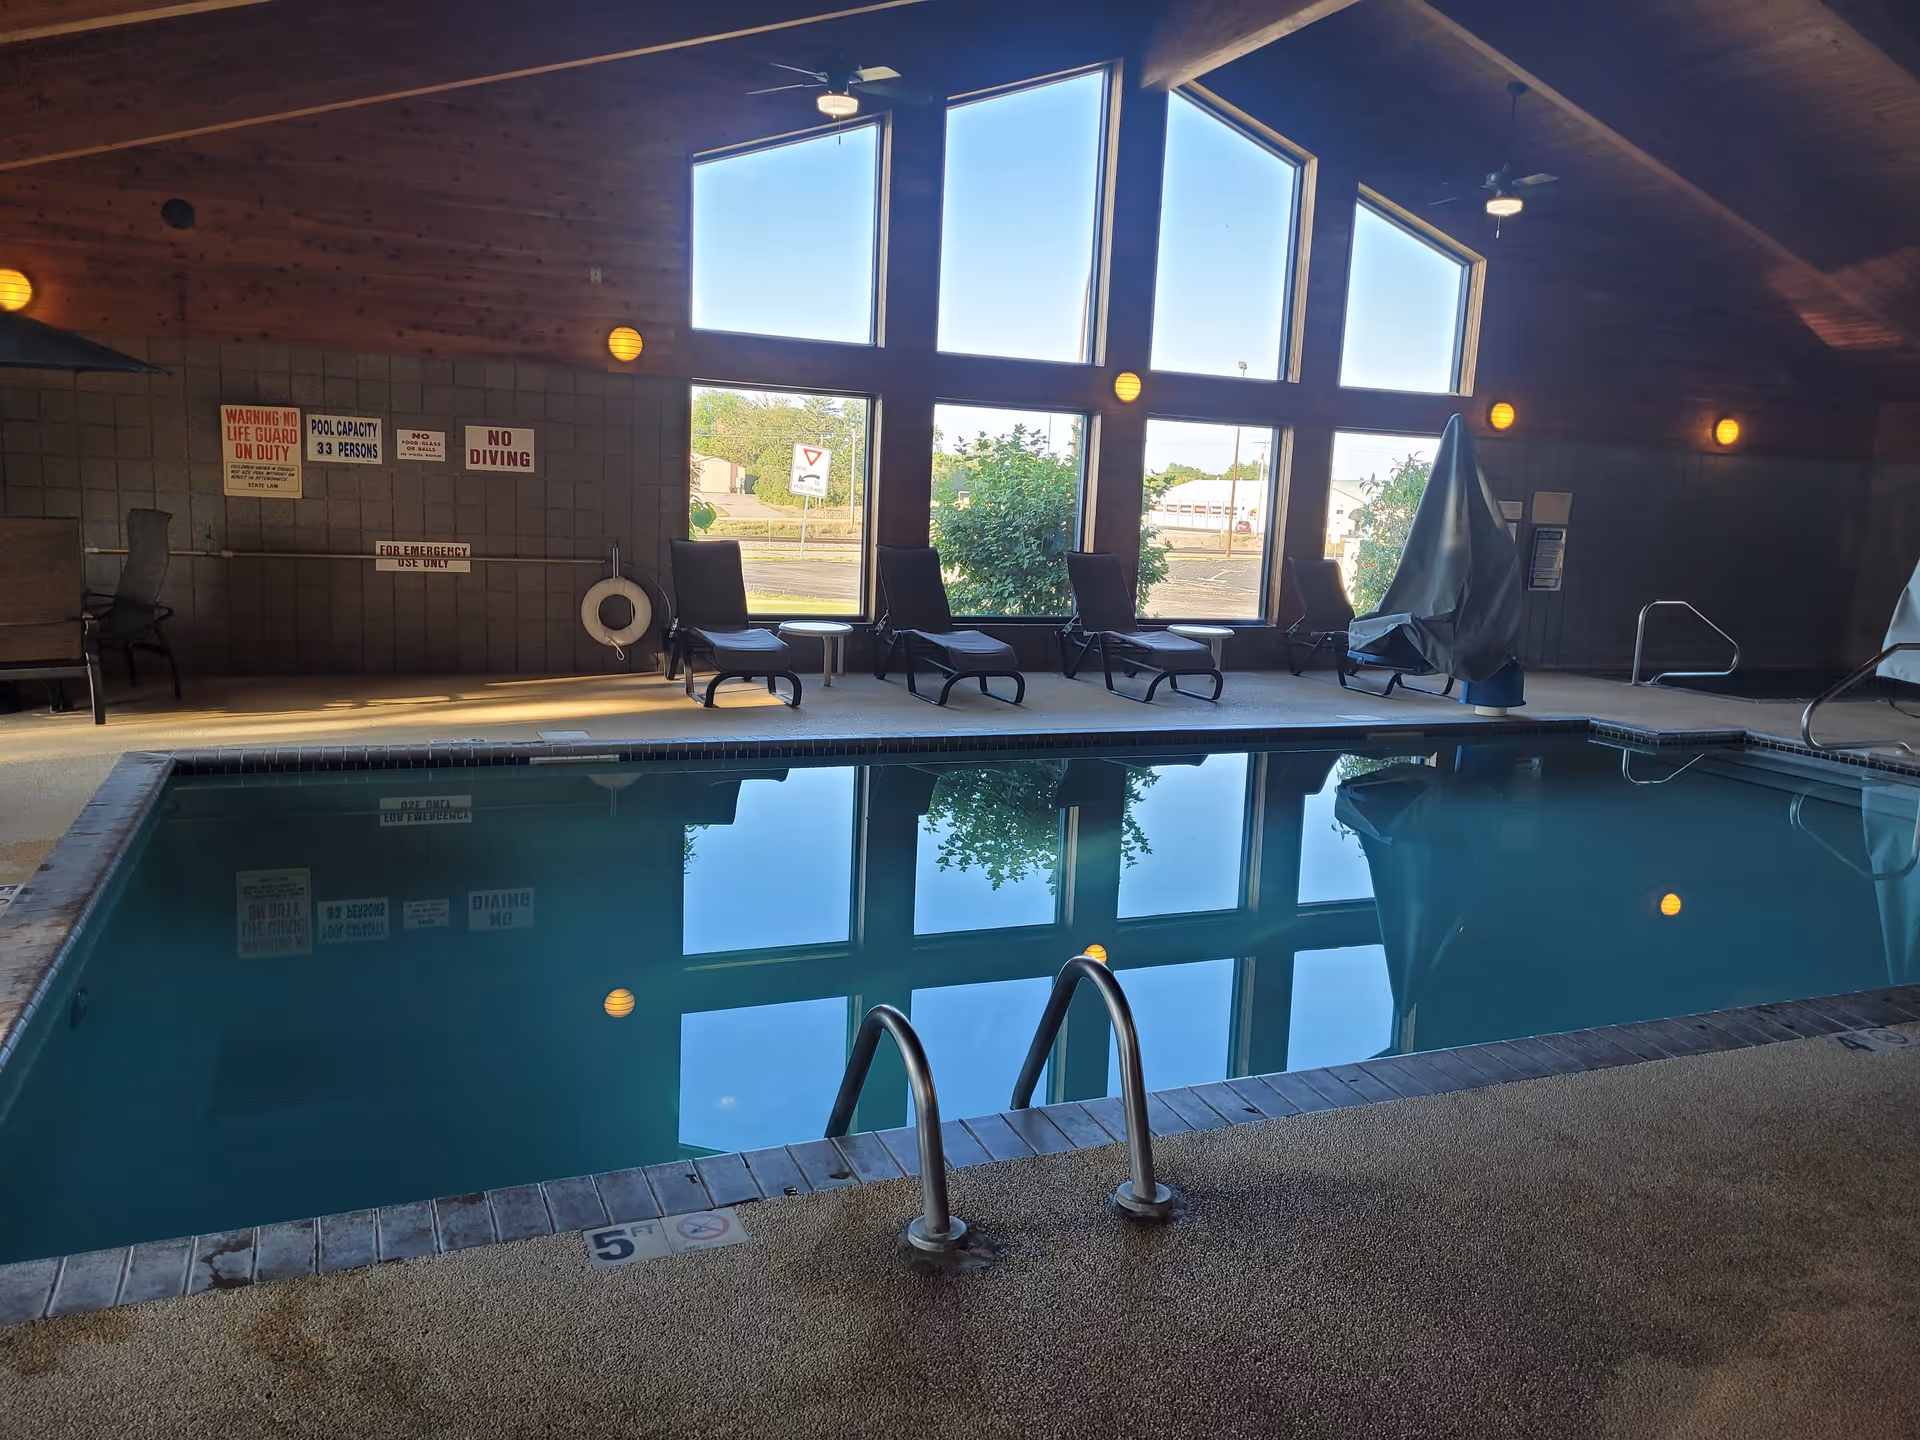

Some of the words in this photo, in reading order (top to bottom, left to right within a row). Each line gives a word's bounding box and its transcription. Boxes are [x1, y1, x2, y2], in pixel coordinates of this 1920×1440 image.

[284, 411, 297, 427] NO
[227, 426, 250, 441] LIFE
[255, 427, 297, 444] GUARD
[312, 419, 334, 435] POOL
[337, 421, 377, 438] CAPACITY
[488, 430, 511, 446] NO
[235, 442, 252, 459] ON
[257, 444, 289, 461] DUTY
[339, 442, 377, 459] PERSONS
[470, 449, 530, 467] DIVING
[380, 545, 400, 556] FOR
[404, 545, 467, 557] EMERGENCY
[398, 559, 418, 567] USE
[424, 559, 449, 568] ONLY
[592, 1229, 635, 1261] 5
[630, 1223, 656, 1237] FT
